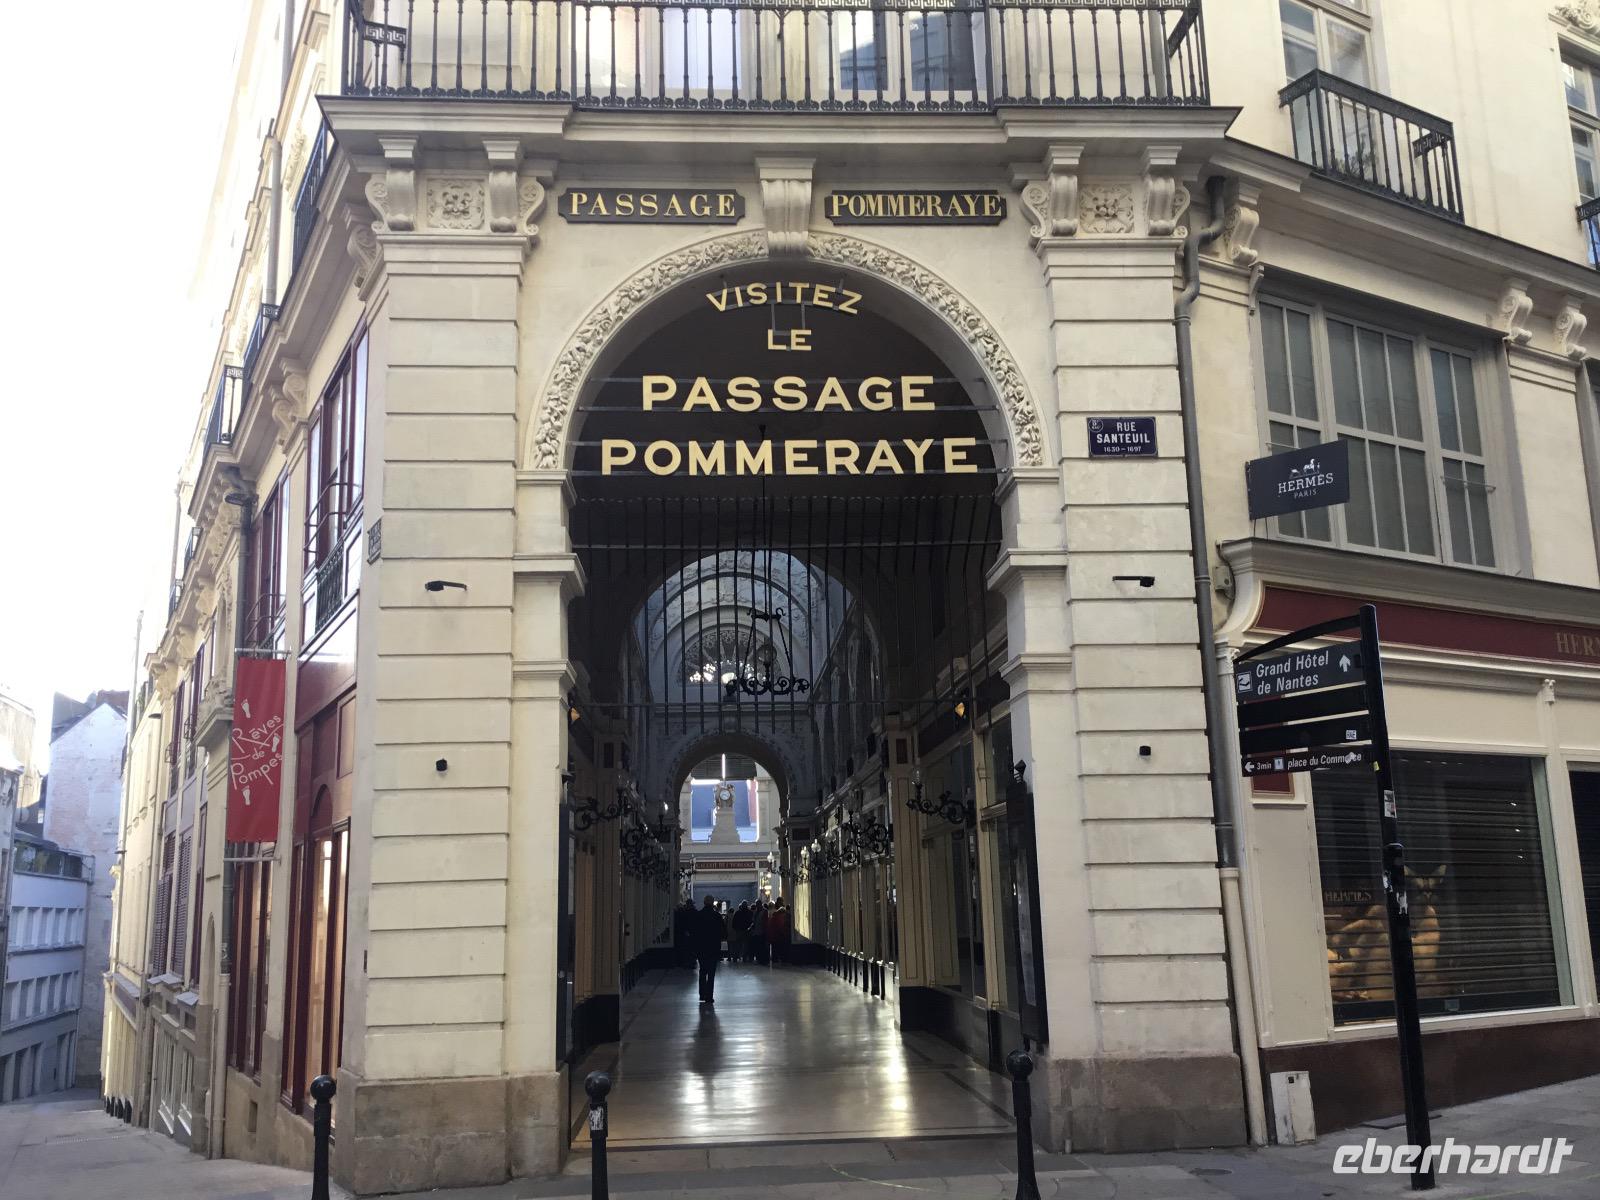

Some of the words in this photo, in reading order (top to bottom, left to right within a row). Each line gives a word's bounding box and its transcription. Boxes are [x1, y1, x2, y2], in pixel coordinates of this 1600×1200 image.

[569, 192, 735, 218] PASSAGE
[831, 193, 1002, 218] POMMERAYE
[706, 282, 862, 314] VISITEZ
[767, 328, 812, 351] LE
[641, 375, 936, 412] PASSAGE
[1096, 433, 1151, 443] SANTEUIL
[1116, 421, 1137, 432] RUE
[601, 437, 978, 476] POMMERAYE
[1294, 488, 1317, 499] PARIS
[1256, 658, 1291, 678] Grand
[1295, 651, 1329, 671] Hôtel
[1257, 681, 1271, 695] de
[1276, 673, 1319, 692] Nantes
[251, 747, 265, 760] de
[1287, 758, 1307, 770] place
[1309, 756, 1319, 766] du
[230, 752, 283, 790] Pompes
